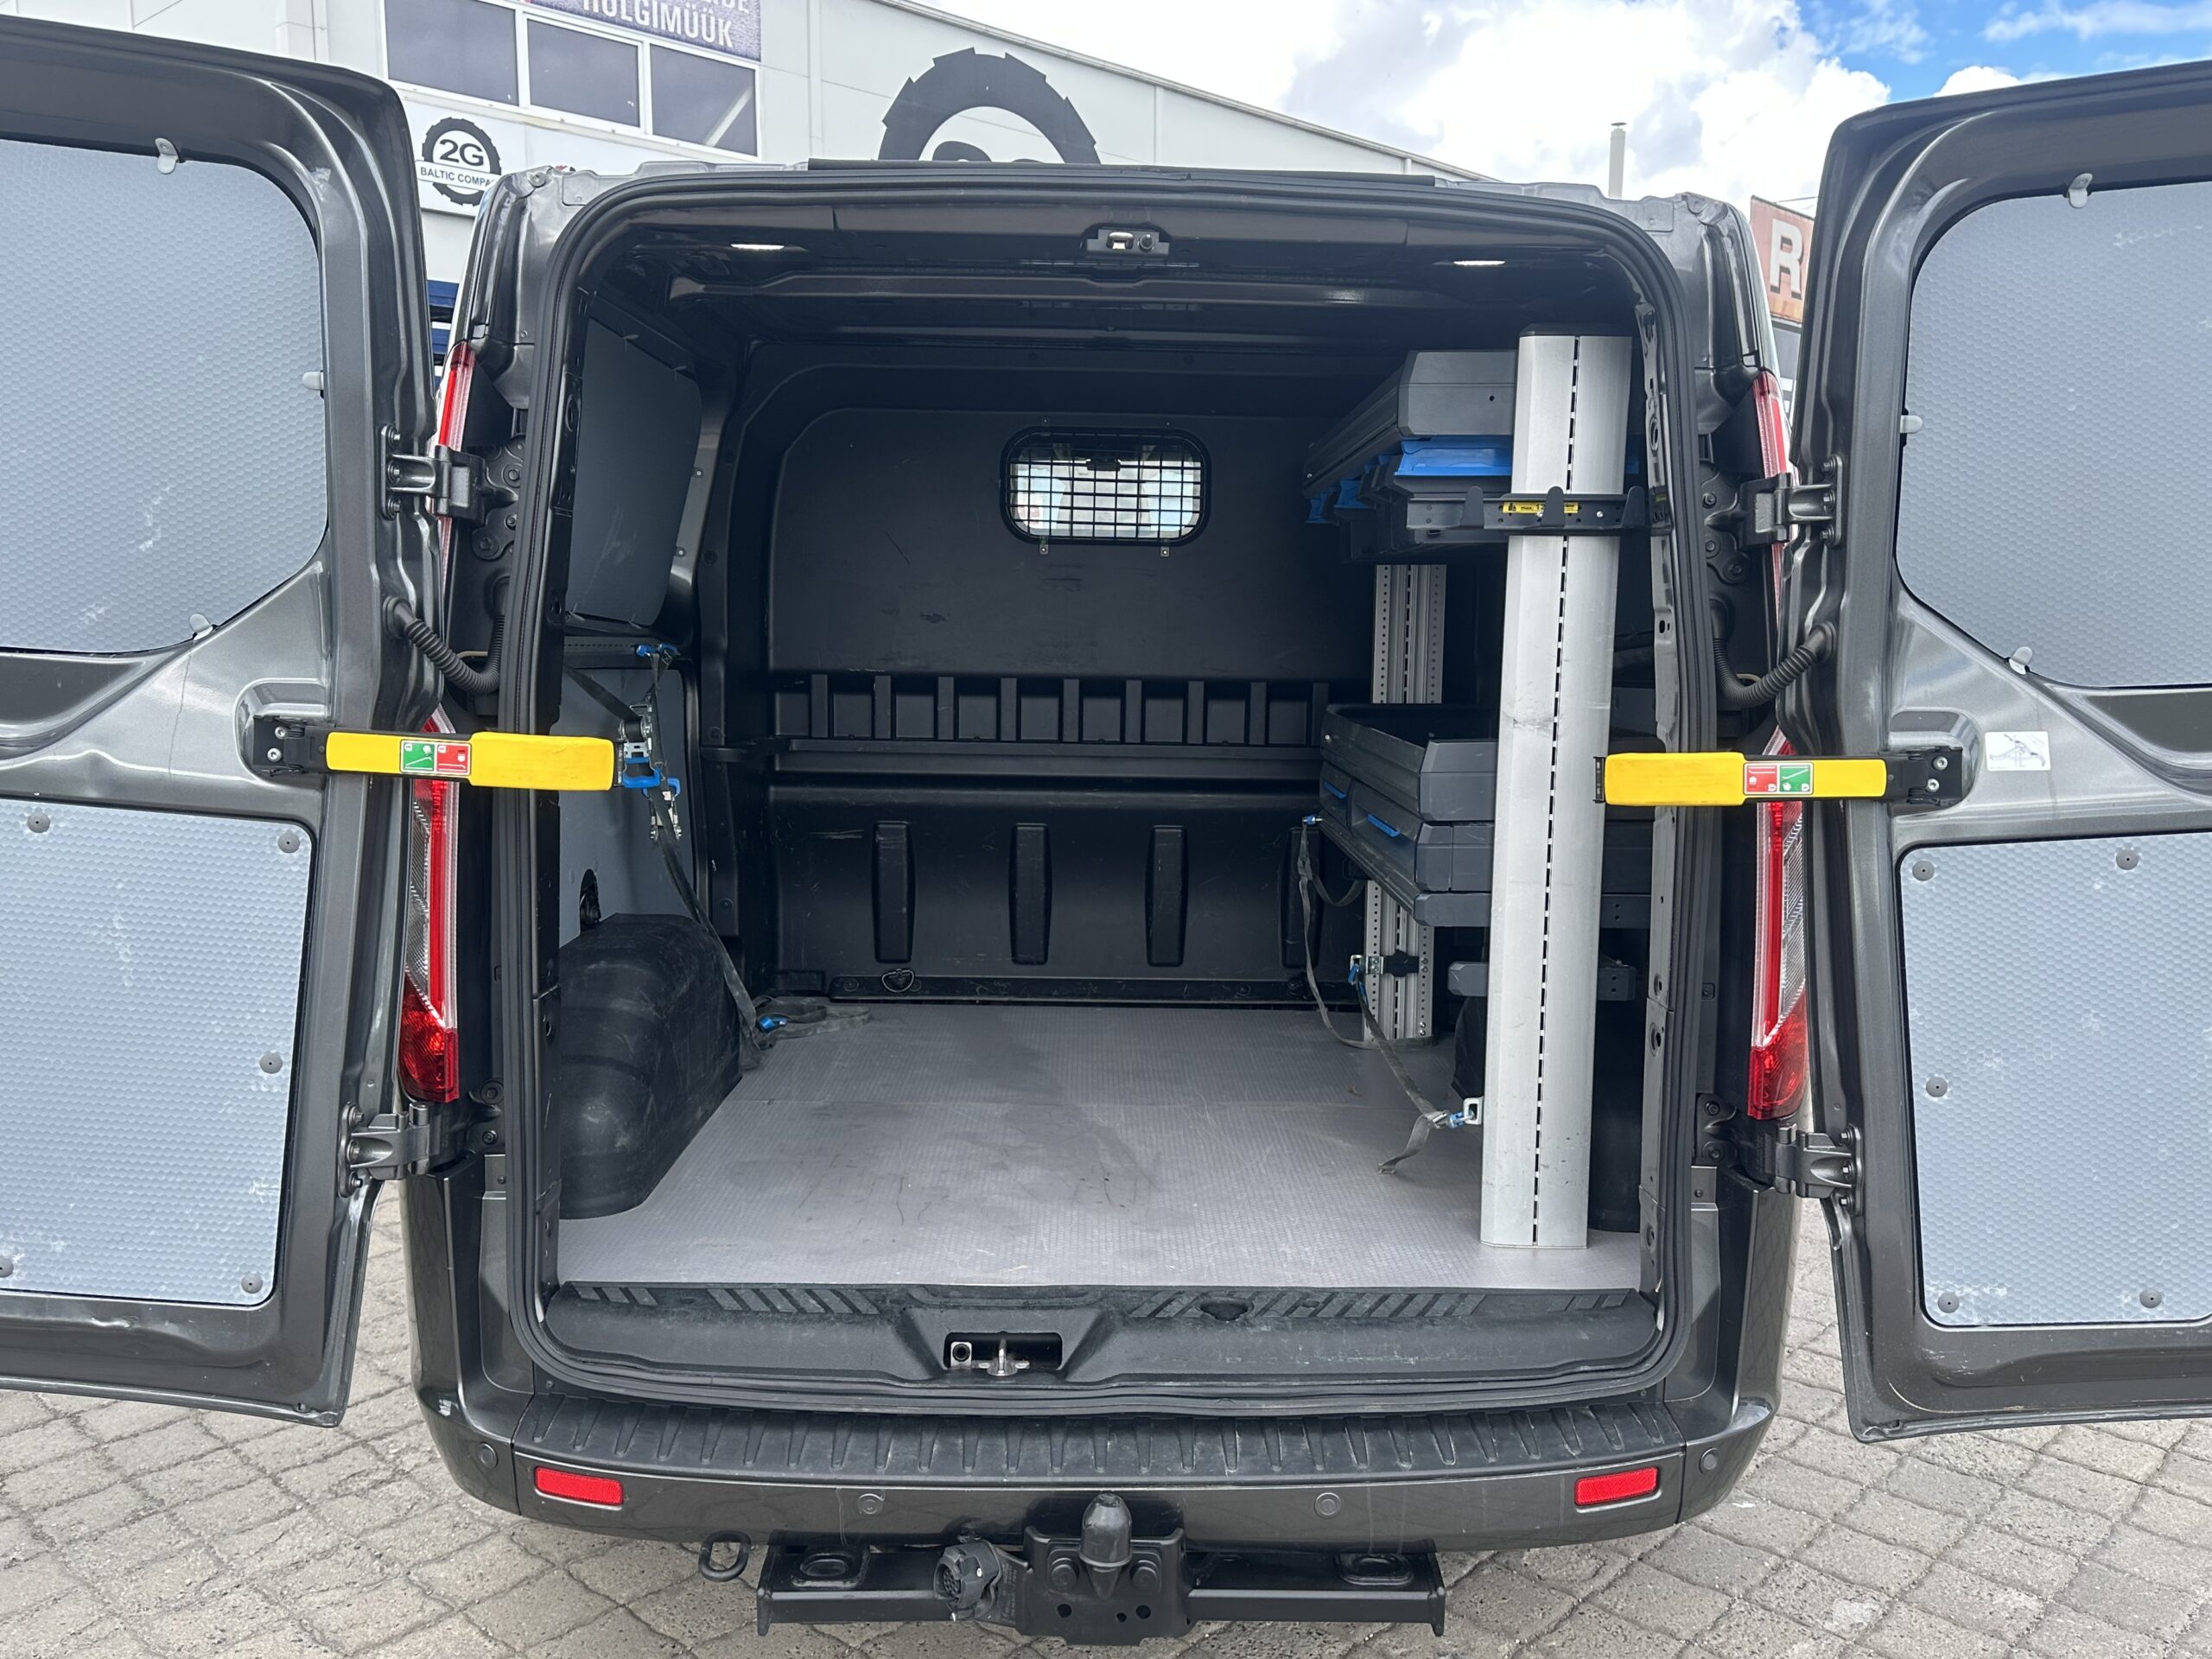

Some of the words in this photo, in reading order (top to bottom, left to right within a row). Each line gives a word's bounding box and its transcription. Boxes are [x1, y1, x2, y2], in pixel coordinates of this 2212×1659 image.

[439, 138, 484, 166] 2G
[420, 167, 454, 181] BALTIC
[457, 173, 493, 187] COMPA
[1770, 218, 1803, 299] R
